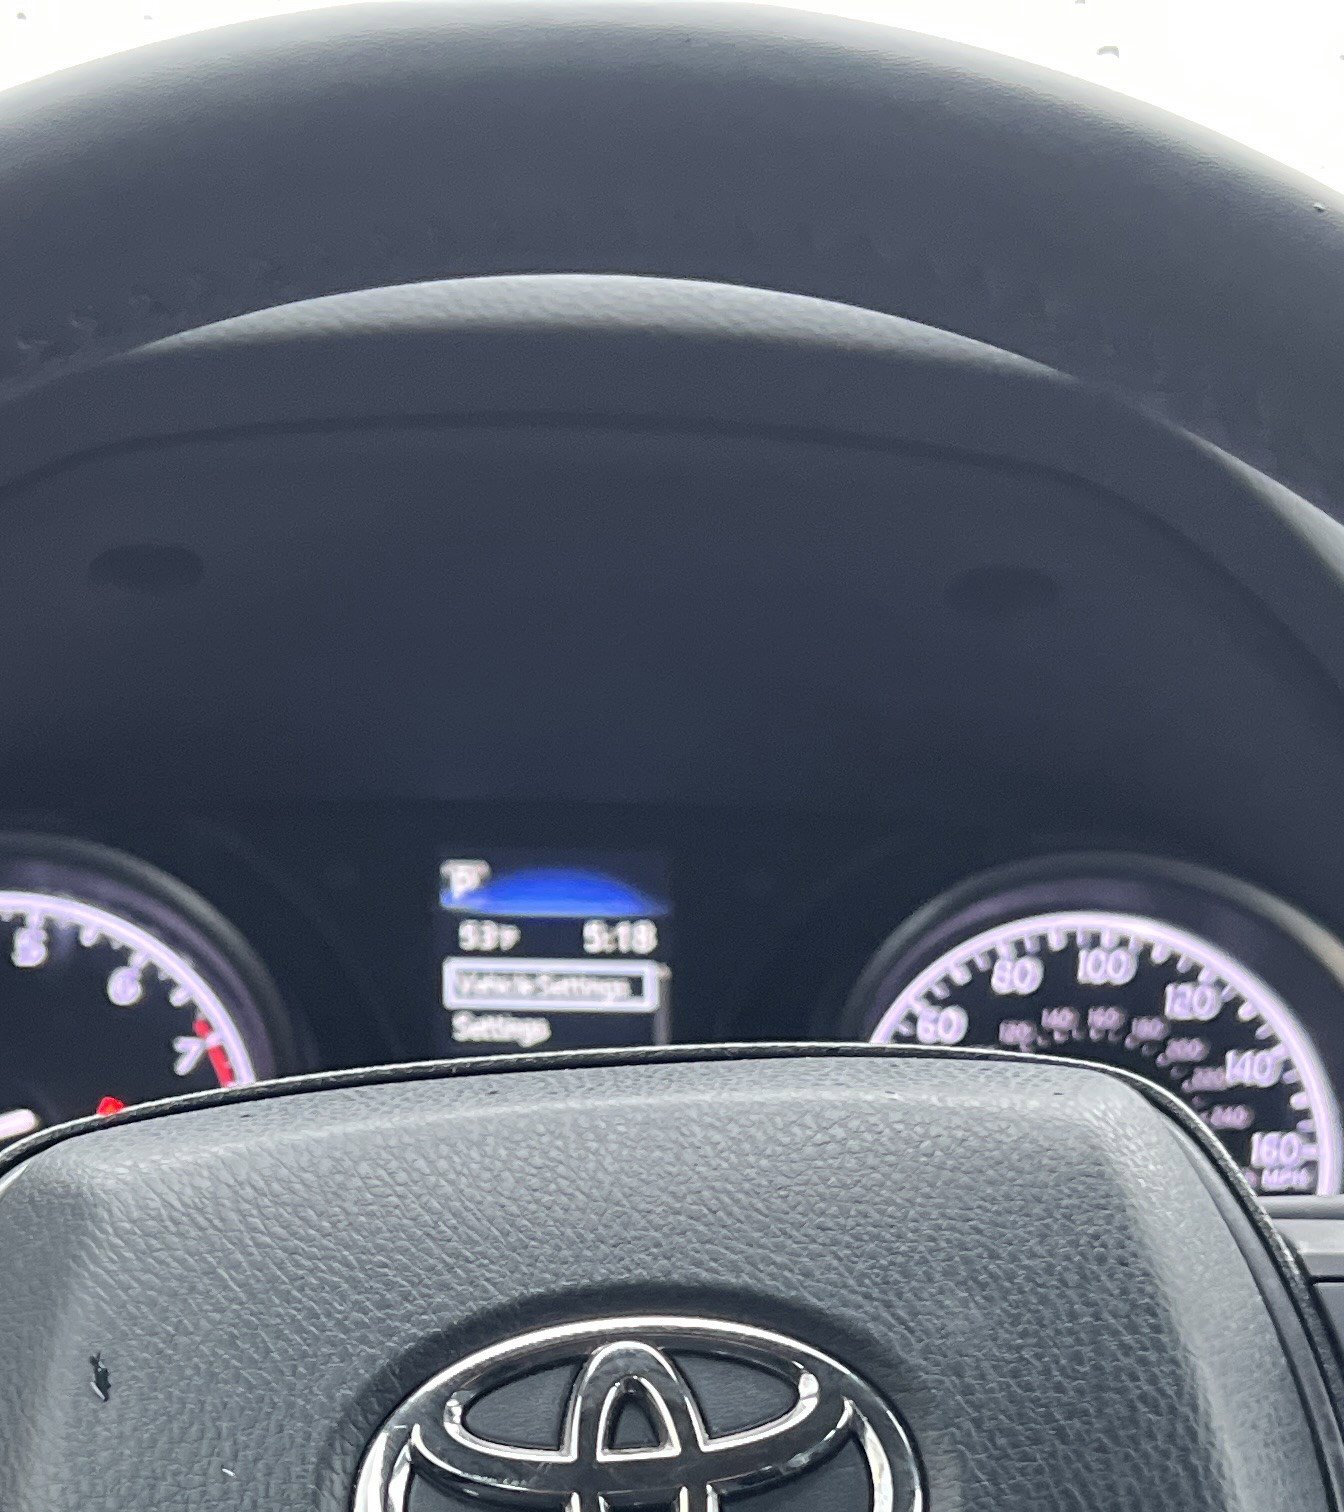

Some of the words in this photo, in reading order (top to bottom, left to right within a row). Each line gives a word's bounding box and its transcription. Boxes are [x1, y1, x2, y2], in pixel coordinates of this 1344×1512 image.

[991, 955, 1044, 995] 80
[1077, 948, 1138, 985] 100
[1164, 982, 1223, 1020] 120
[916, 1005, 968, 1045] 60
[173, 1035, 206, 1076] 7
[1225, 1048, 1282, 1088] 140
[1250, 1131, 1304, 1168] 160
